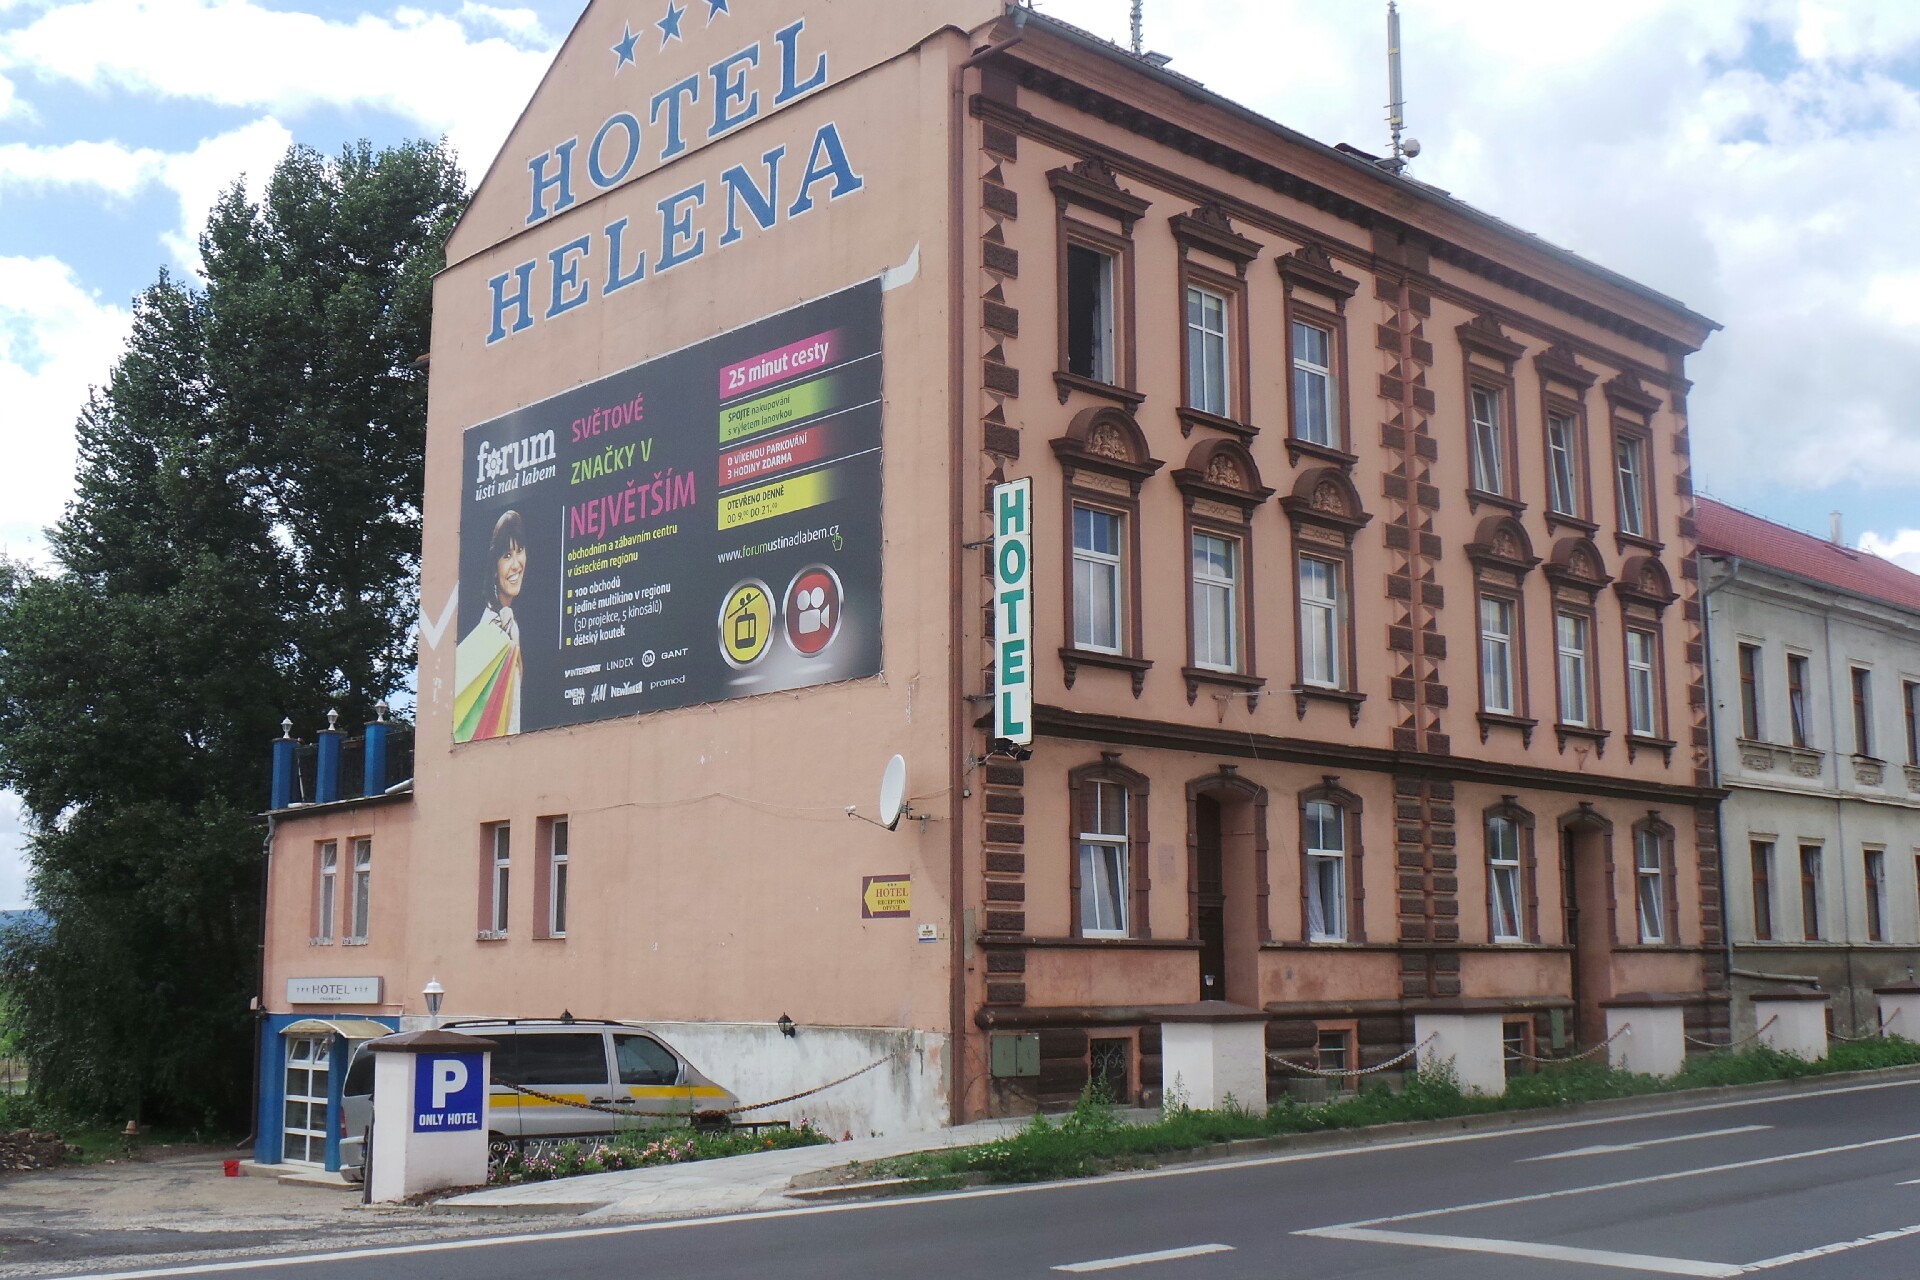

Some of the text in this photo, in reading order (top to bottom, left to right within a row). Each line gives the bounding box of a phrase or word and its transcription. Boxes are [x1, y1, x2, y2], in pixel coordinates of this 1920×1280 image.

[525, 17, 828, 226] HOTEL
[485, 121, 864, 346] HELENA
[728, 342, 829, 389] 25 minut cesty
[571, 391, 644, 443] SVĚTOVÉ
[728, 394, 791, 423] SPOJTE nakupování
[728, 409, 793, 436] s výletem lanovkou
[570, 437, 653, 485] ZNAČKY V
[734, 446, 765, 464] VÍKENDU
[766, 432, 808, 455] PARKOVÁNÍ
[727, 452, 793, 479] 3 HODINY ZDARMA
[475, 464, 556, 501] ústí nad labem
[570, 467, 697, 540] NEJVĚTŠÍM
[727, 485, 785, 511] OTEVŘENO DENNĚ
[727, 511, 736, 524] OD
[750, 507, 760, 518] DO
[567, 524, 678, 562] obchodním a zábavním centru
[718, 524, 840, 564] www.forumustinadlabem.cz
[567, 551, 639, 578] v ústeckém regionu
[574, 583, 671, 617] jediné multikino v regionu
[575, 575, 621, 598] 100 obchodů
[574, 599, 663, 633] (3D projekce, 5 kinosálů)
[999, 488, 1026, 736] HOTEL
[573, 624, 626, 647] dětský koutek
[606, 657, 634, 671] LINDEX
[661, 648, 689, 660] GANT
[564, 687, 586, 699] CINEMA
[650, 675, 686, 690] promod
[572, 695, 585, 706] CITY
[876, 887, 908, 897] HOTEL
[312, 984, 350, 995] HOTEL
[432, 1059, 469, 1109] P
[418, 1112, 478, 1126] ONLY HOTEL
